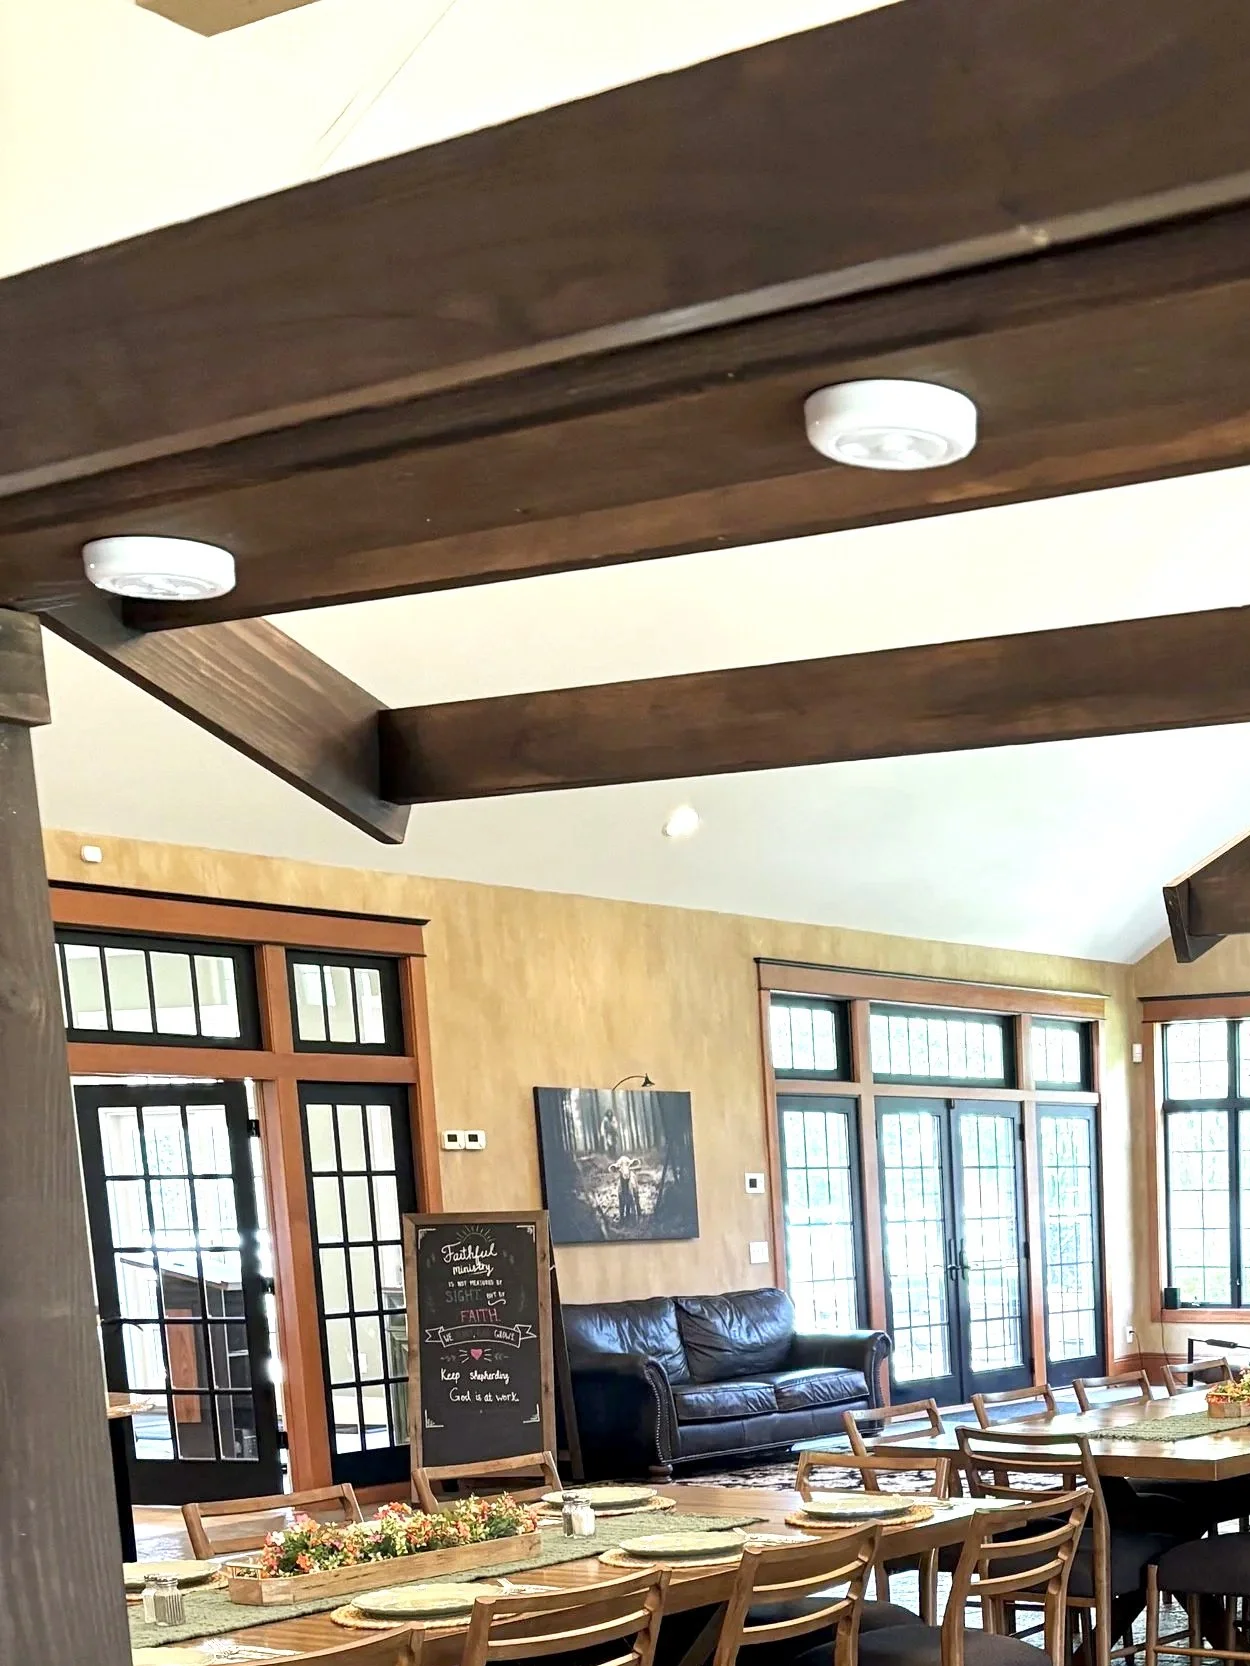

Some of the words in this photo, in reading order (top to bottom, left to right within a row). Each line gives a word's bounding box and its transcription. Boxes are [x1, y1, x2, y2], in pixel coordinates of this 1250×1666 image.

[441, 1242, 498, 1265] Faithful
[445, 1289, 481, 1303] SIGHT
[440, 1368, 460, 1384] Keep
[449, 1387, 471, 1402] God
[475, 1391, 482, 1402] is
[484, 1392, 493, 1402] at
